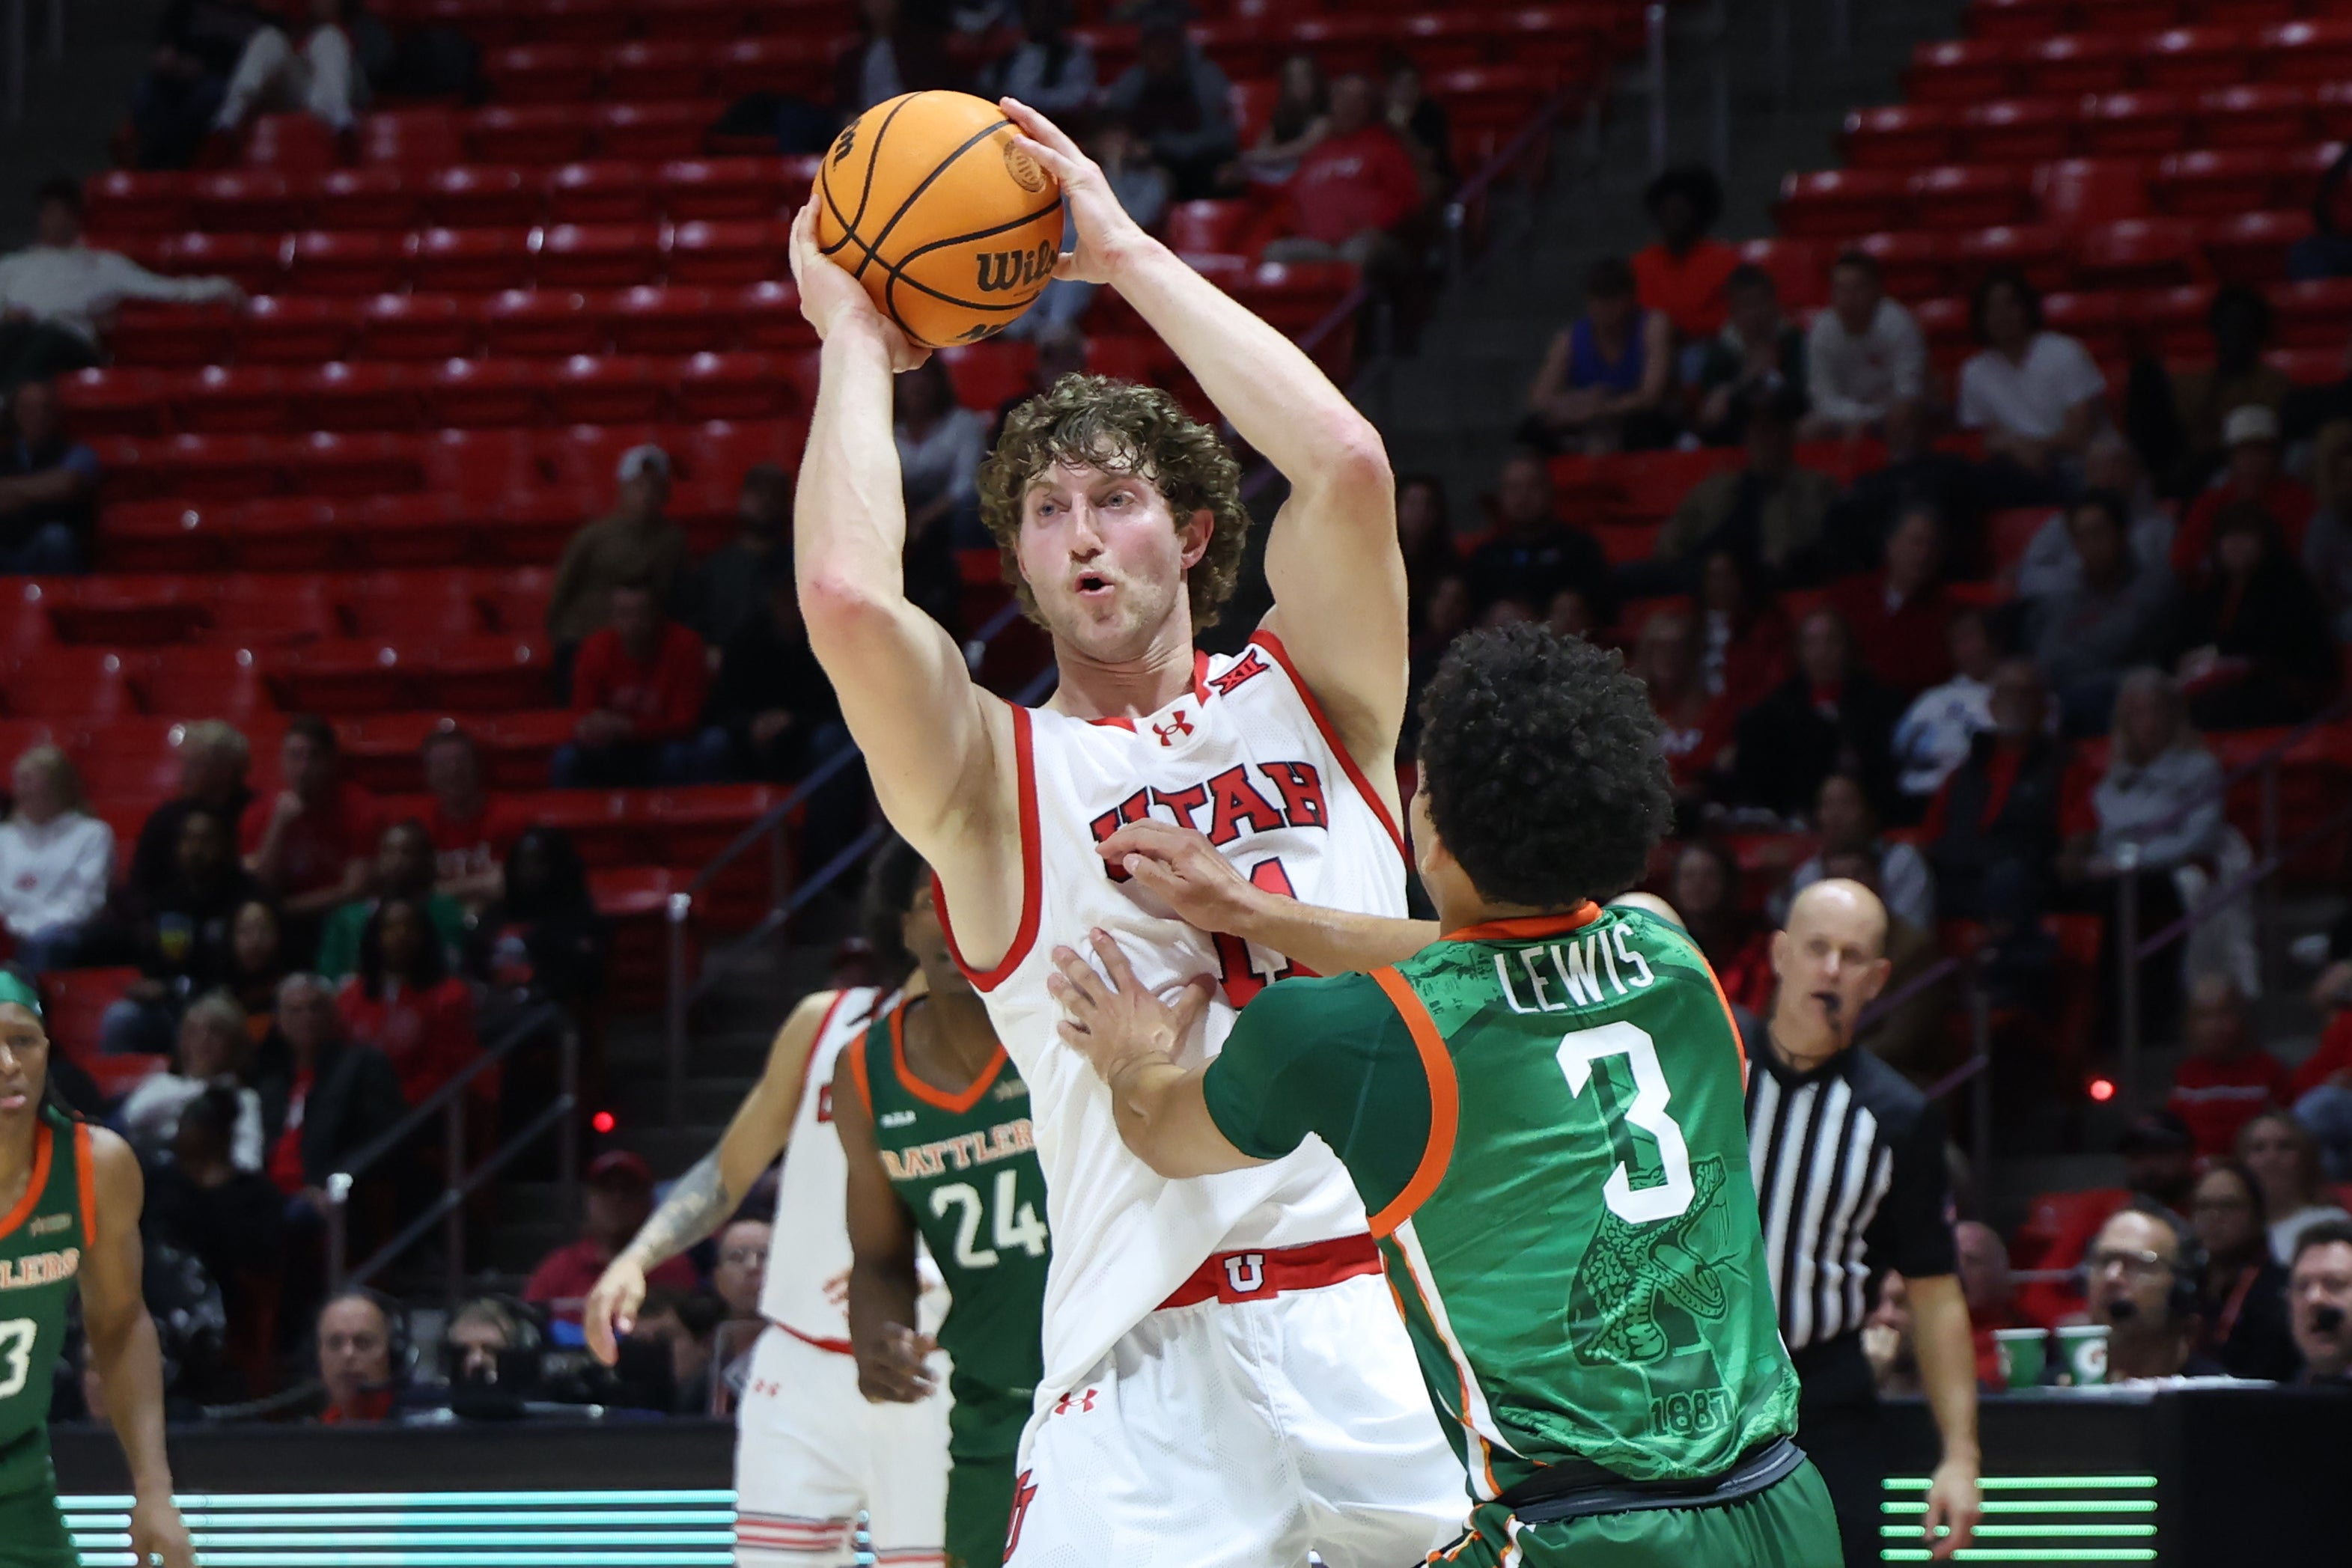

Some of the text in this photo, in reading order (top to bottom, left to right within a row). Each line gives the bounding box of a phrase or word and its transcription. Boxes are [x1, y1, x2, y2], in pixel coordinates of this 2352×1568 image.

[1493, 922, 1655, 1015] LEWIS
[881, 1117, 1035, 1181] RATTLER
[1555, 1019, 1696, 1225] 3
[928, 1168, 1049, 1269] 24
[0, 1247, 81, 1290] LERS
[1223, 1253, 1265, 1294] U
[1649, 1387, 1736, 1438] 1887
